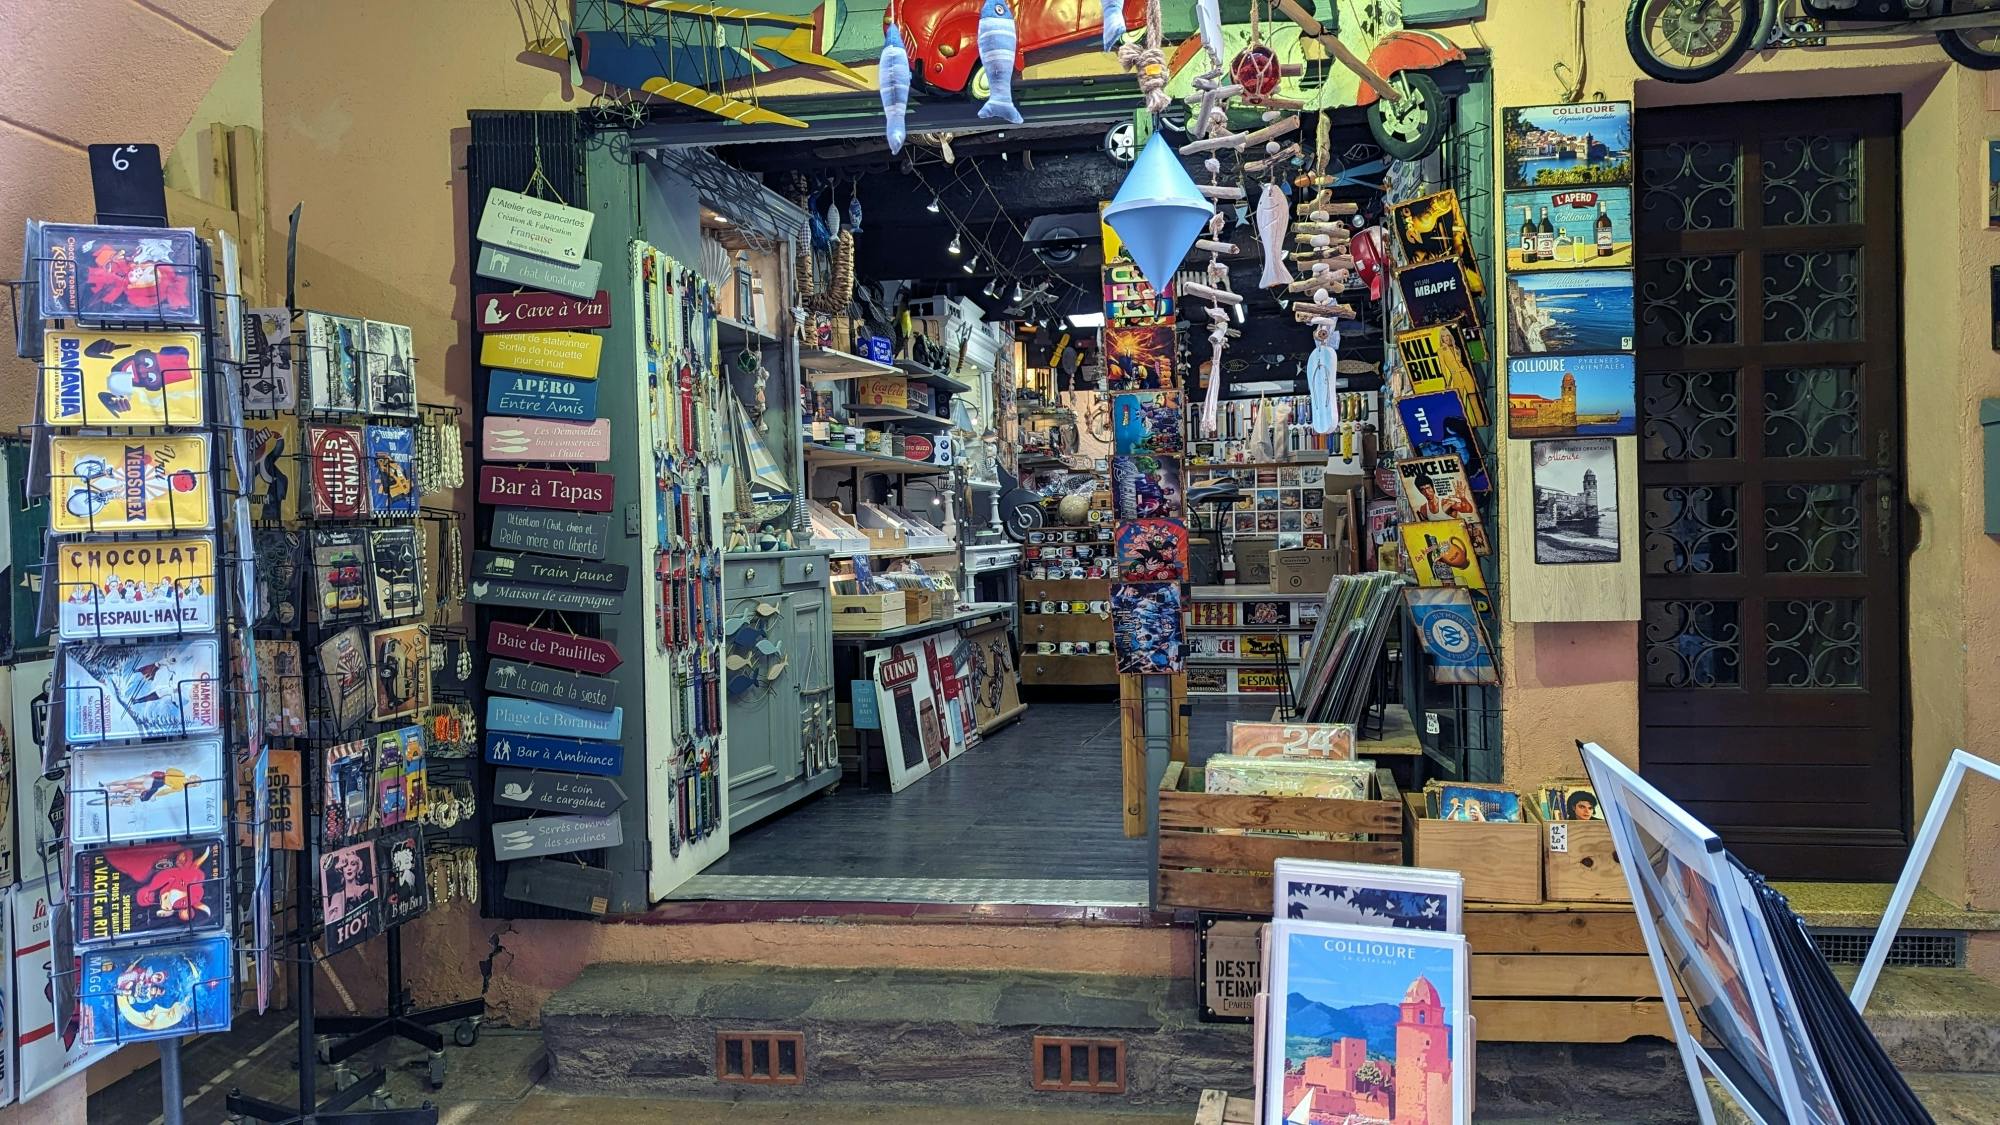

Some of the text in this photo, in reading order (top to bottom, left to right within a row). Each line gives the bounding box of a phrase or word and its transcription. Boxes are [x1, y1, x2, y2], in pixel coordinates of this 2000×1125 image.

[1552, 105, 1615, 116] COLLIOURE
[1556, 192, 1592, 205] L'APERO
[491, 197, 585, 228] L'Atelier des pancartes
[1555, 211, 1595, 223] Collioure
[510, 226, 553, 244] Française
[535, 221, 572, 237] Fabrication
[1523, 237, 1536, 250] 51
[519, 266, 538, 279] chat
[1415, 277, 1457, 298] MBAPPÉ
[515, 300, 602, 320] Cave à Vin
[498, 341, 583, 360] Sortie de brouette
[528, 334, 540, 344] de
[542, 336, 590, 349] stationner
[1400, 337, 1438, 362] KILL
[243, 358, 261, 379] GIN
[513, 357, 565, 369] jour et nuit
[1407, 358, 1443, 383] BILL
[1512, 358, 1566, 373] COLLIOURE
[60, 339, 80, 417] BANANIA
[512, 377, 576, 395] APÉRO
[499, 397, 585, 415] Entre Amis
[534, 427, 602, 436] Les Demoiselles
[535, 438, 553, 447] bien
[322, 438, 344, 504] HUILES
[338, 436, 360, 506] RENAULT
[1400, 461, 1439, 478] BRUCE
[1440, 459, 1460, 474] LEE
[490, 476, 603, 503] Bar à Tapas
[566, 522, 584, 534] chien
[585, 525, 593, 535] et
[499, 528, 598, 554] Belle mère en liberté
[71, 547, 198, 567] CHOCOLAT
[530, 564, 613, 583] Train jaune
[495, 585, 615, 609] Maison de campagne
[496, 632, 606, 664] Baie de Paulilles
[1189, 639, 1234, 653] FRANCE
[883, 657, 918, 682] CUISINE
[200, 672, 211, 726] CHAMONIX
[516, 673, 608, 706] Le coin de la sieste
[495, 707, 609, 731] Plage de Boramar
[1282, 727, 1334, 756] 24
[516, 746, 614, 766] Bar à Ambiance
[246, 787, 291, 807] BER
[556, 781, 593, 794] Le coin
[540, 793, 606, 809] de cargolade
[538, 820, 613, 836] Serrés comme
[544, 832, 606, 848] des sardines
[92, 856, 108, 938] LA VACHE QUI RIT
[111, 883, 120, 901] POIDS
[32, 923, 42, 932] EST
[337, 911, 369, 945] HOT
[1324, 938, 1416, 960] COLLIOURE
